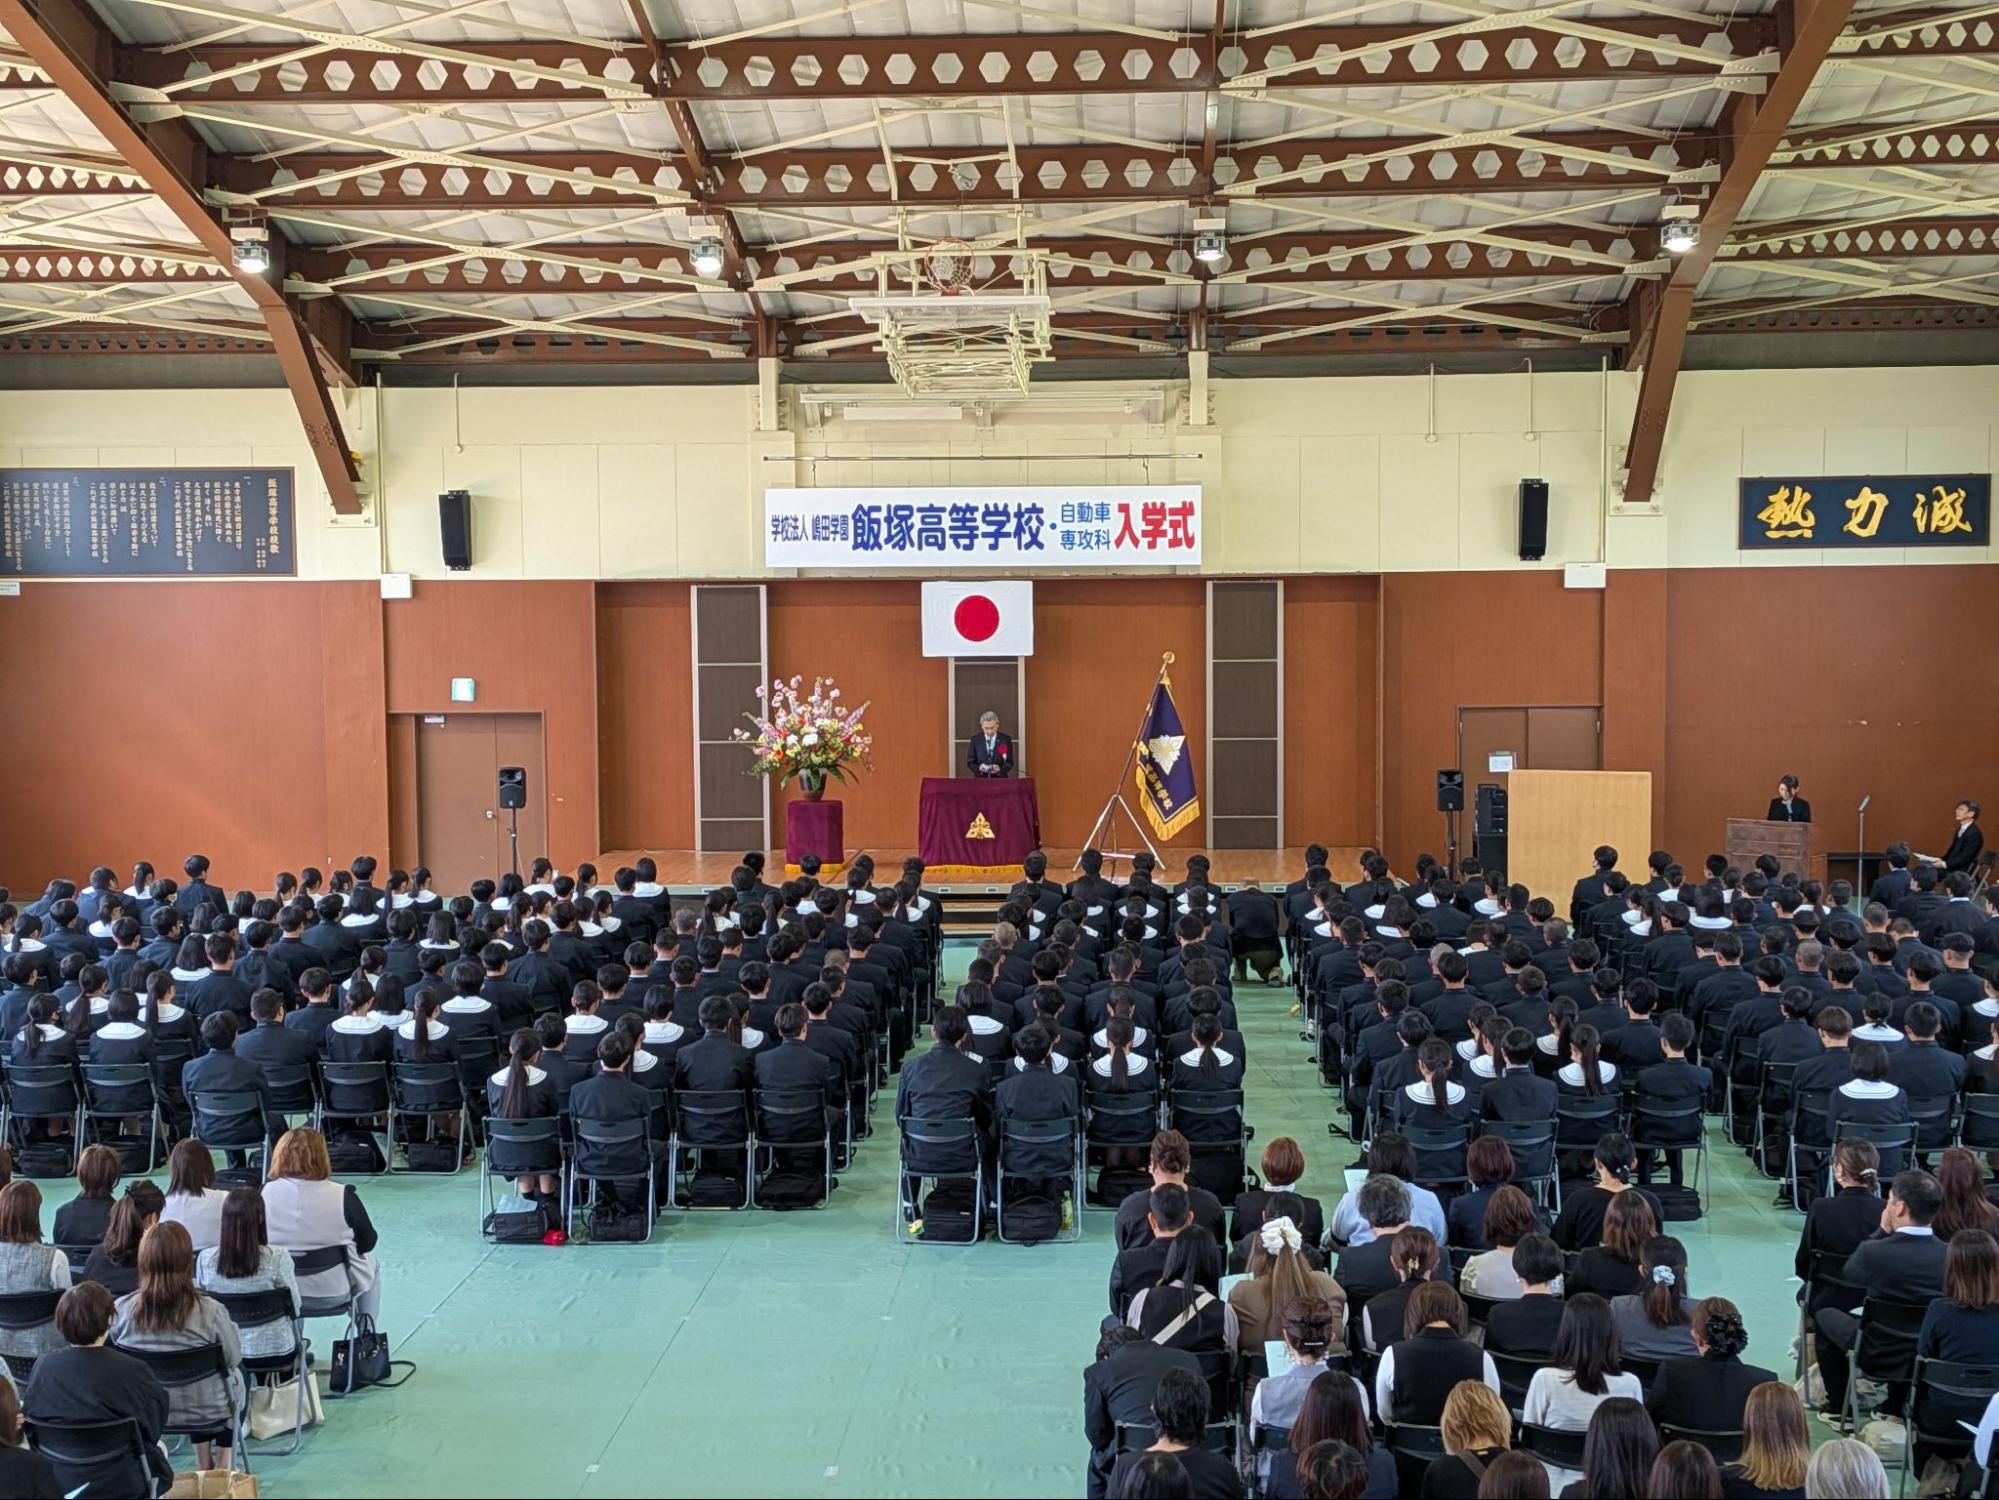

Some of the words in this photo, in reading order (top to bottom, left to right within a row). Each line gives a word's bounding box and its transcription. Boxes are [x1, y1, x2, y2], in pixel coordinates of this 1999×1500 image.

[1060, 501, 1111, 523] 自動車
[771, 514, 808, 542] 学校法人
[1114, 501, 1195, 550] 入学式
[1060, 529, 1111, 550] 専攻科
